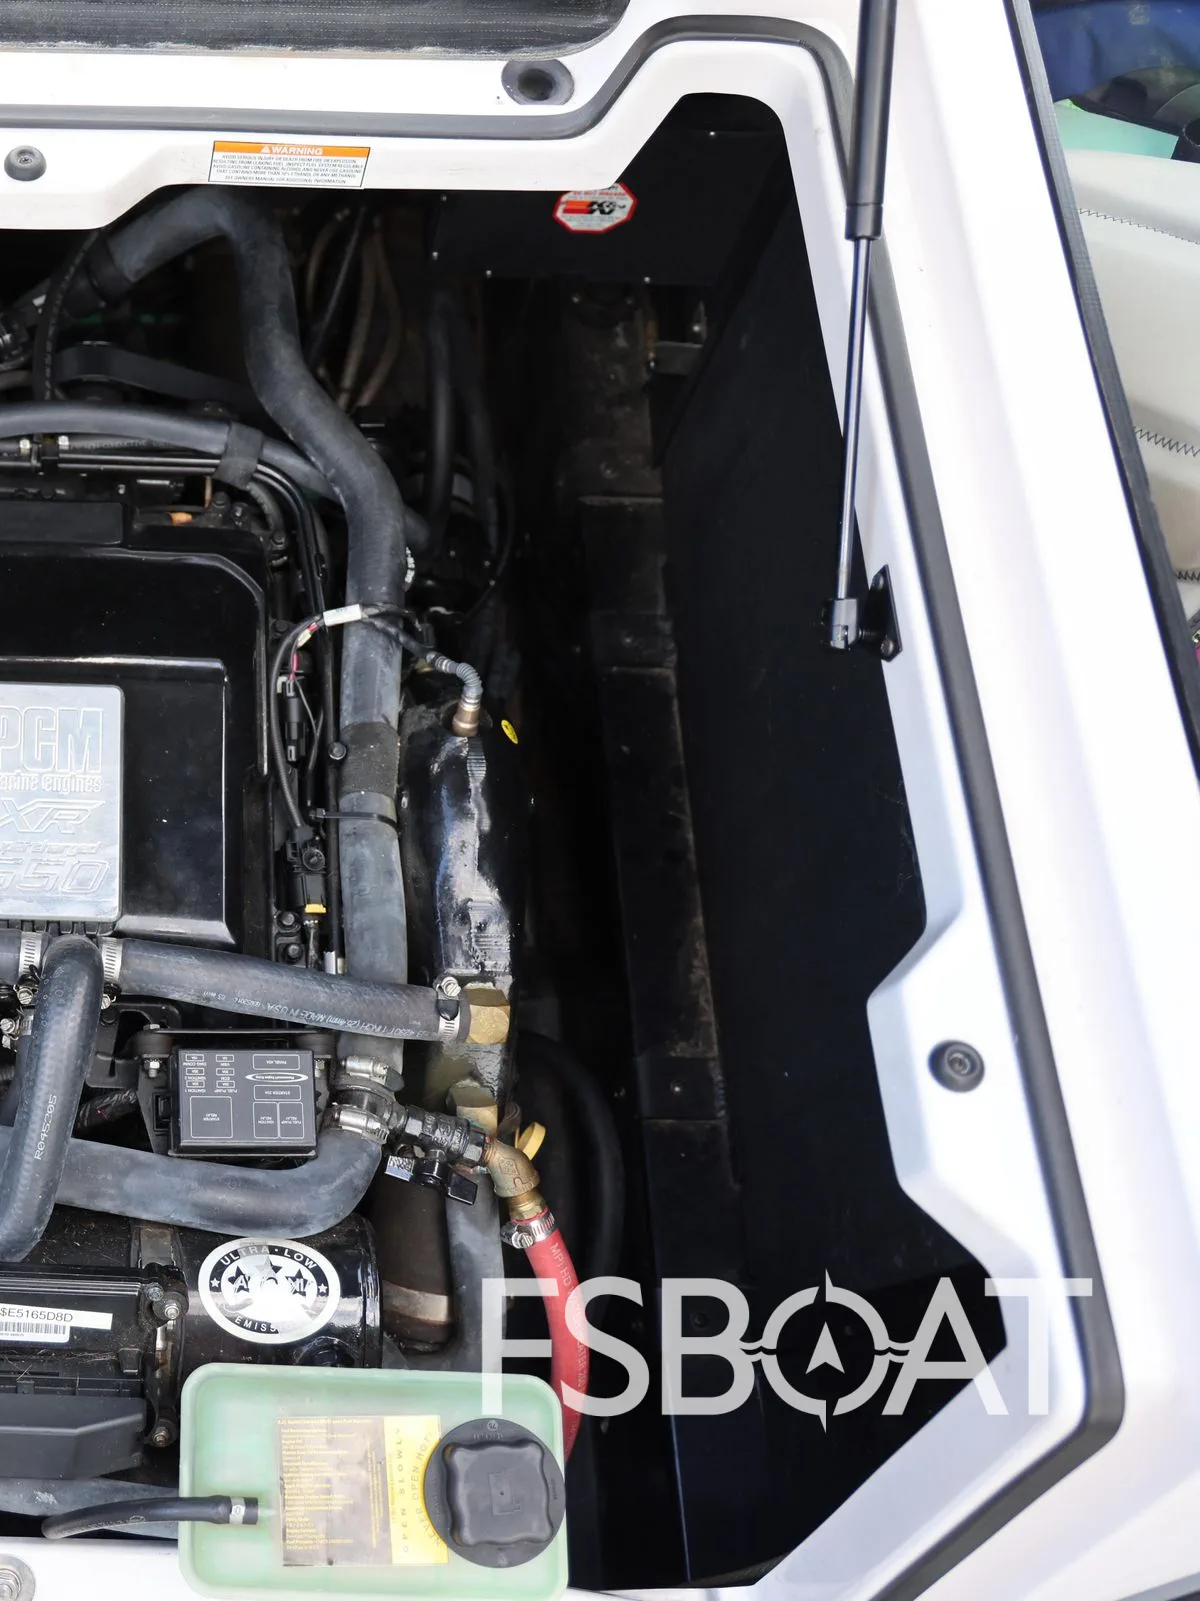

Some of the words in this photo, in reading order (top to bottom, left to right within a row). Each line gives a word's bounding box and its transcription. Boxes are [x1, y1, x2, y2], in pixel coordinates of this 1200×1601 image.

[272, 146, 324, 156] WARNING
[42, 772, 103, 794] engines
[300, 1010, 325, 1022] MADE
[34, 1094, 57, 1160] R045205
[220, 1245, 270, 1266] ULTRA
[284, 1250, 317, 1269] LOW
[0, 1307, 74, 1323] $E5165D8D
[396, 1428, 406, 1494] SLOWLY
[400, 1508, 409, 1552] OPEN
